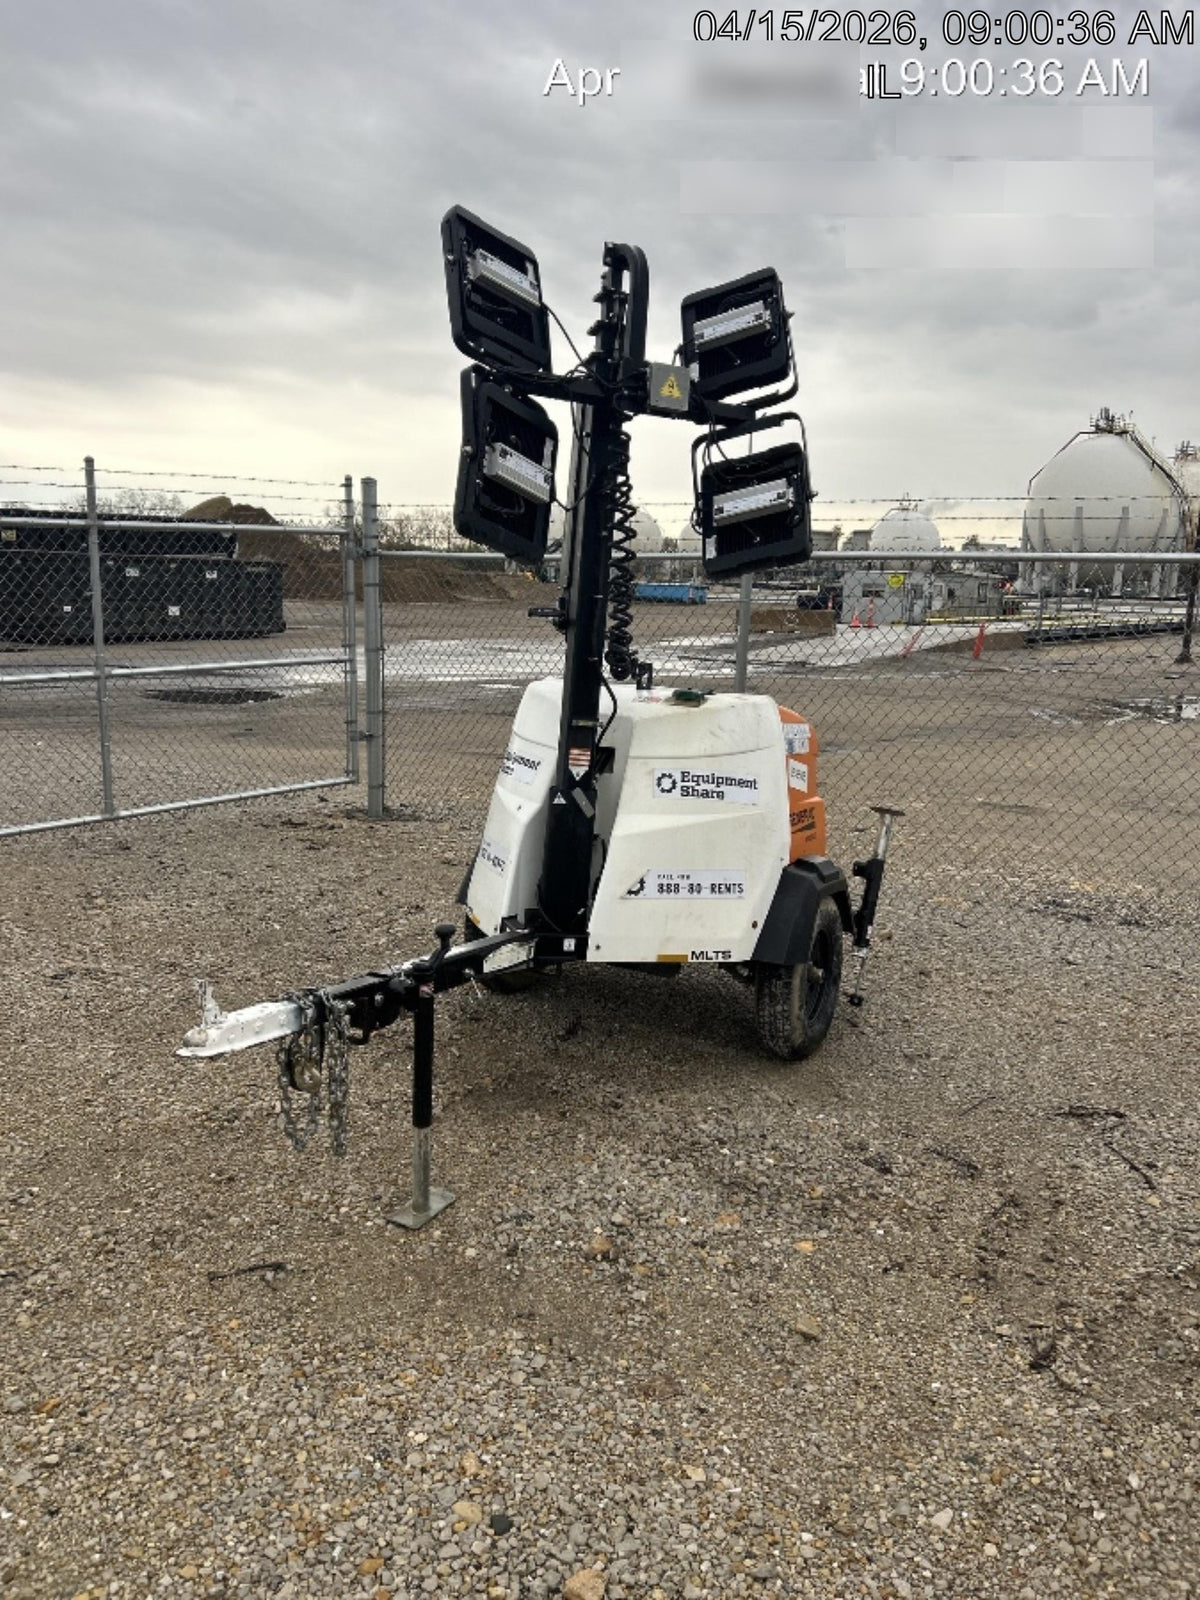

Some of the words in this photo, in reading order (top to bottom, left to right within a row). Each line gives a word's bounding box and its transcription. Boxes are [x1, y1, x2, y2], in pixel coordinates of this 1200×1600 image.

[680, 770, 758, 790] Equipment
[680, 785, 725, 801] Share
[657, 883, 744, 895] 888-80-RENTS
